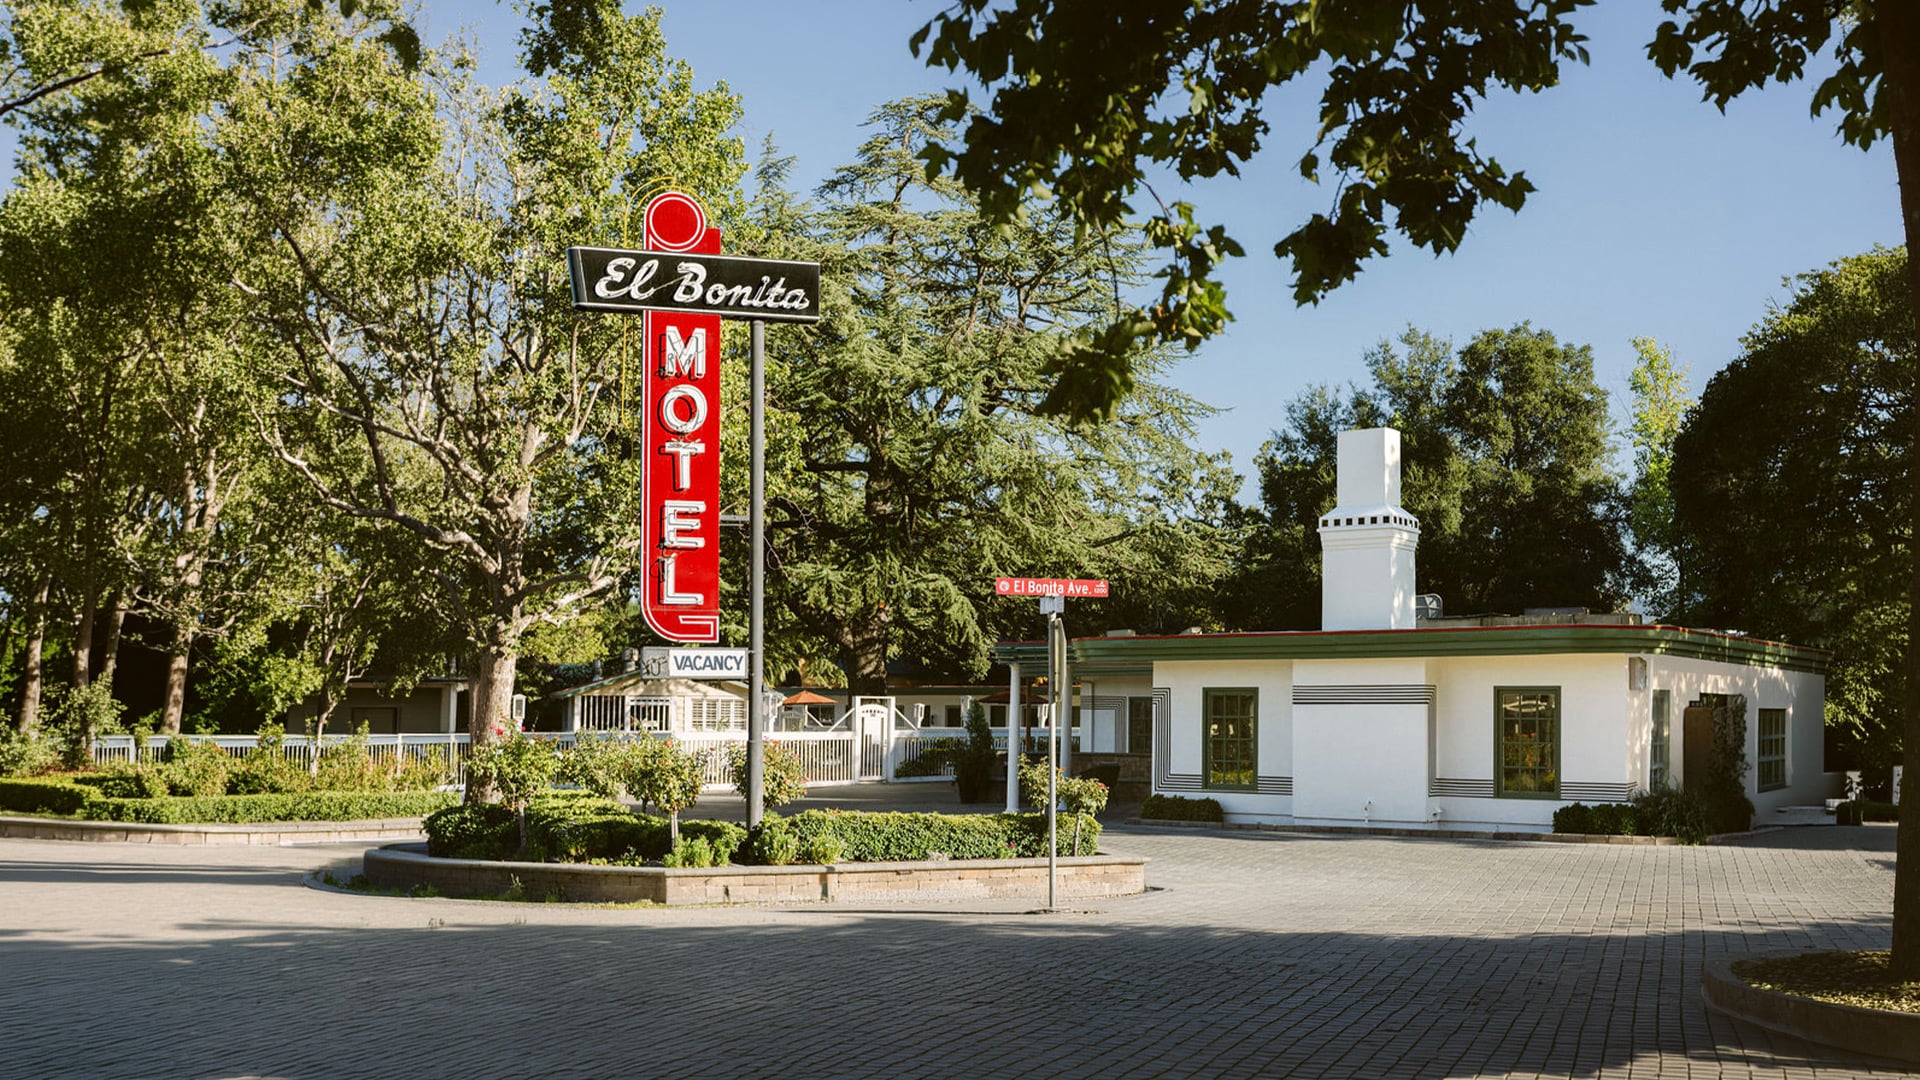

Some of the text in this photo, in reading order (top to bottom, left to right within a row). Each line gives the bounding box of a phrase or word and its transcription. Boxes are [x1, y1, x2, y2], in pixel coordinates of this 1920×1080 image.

[594, 257, 810, 310] El Bonita
[658, 325, 708, 606] MOTEL
[1013, 580, 1092, 594] El Bonita Ave.
[673, 655, 744, 671] VACANCY
